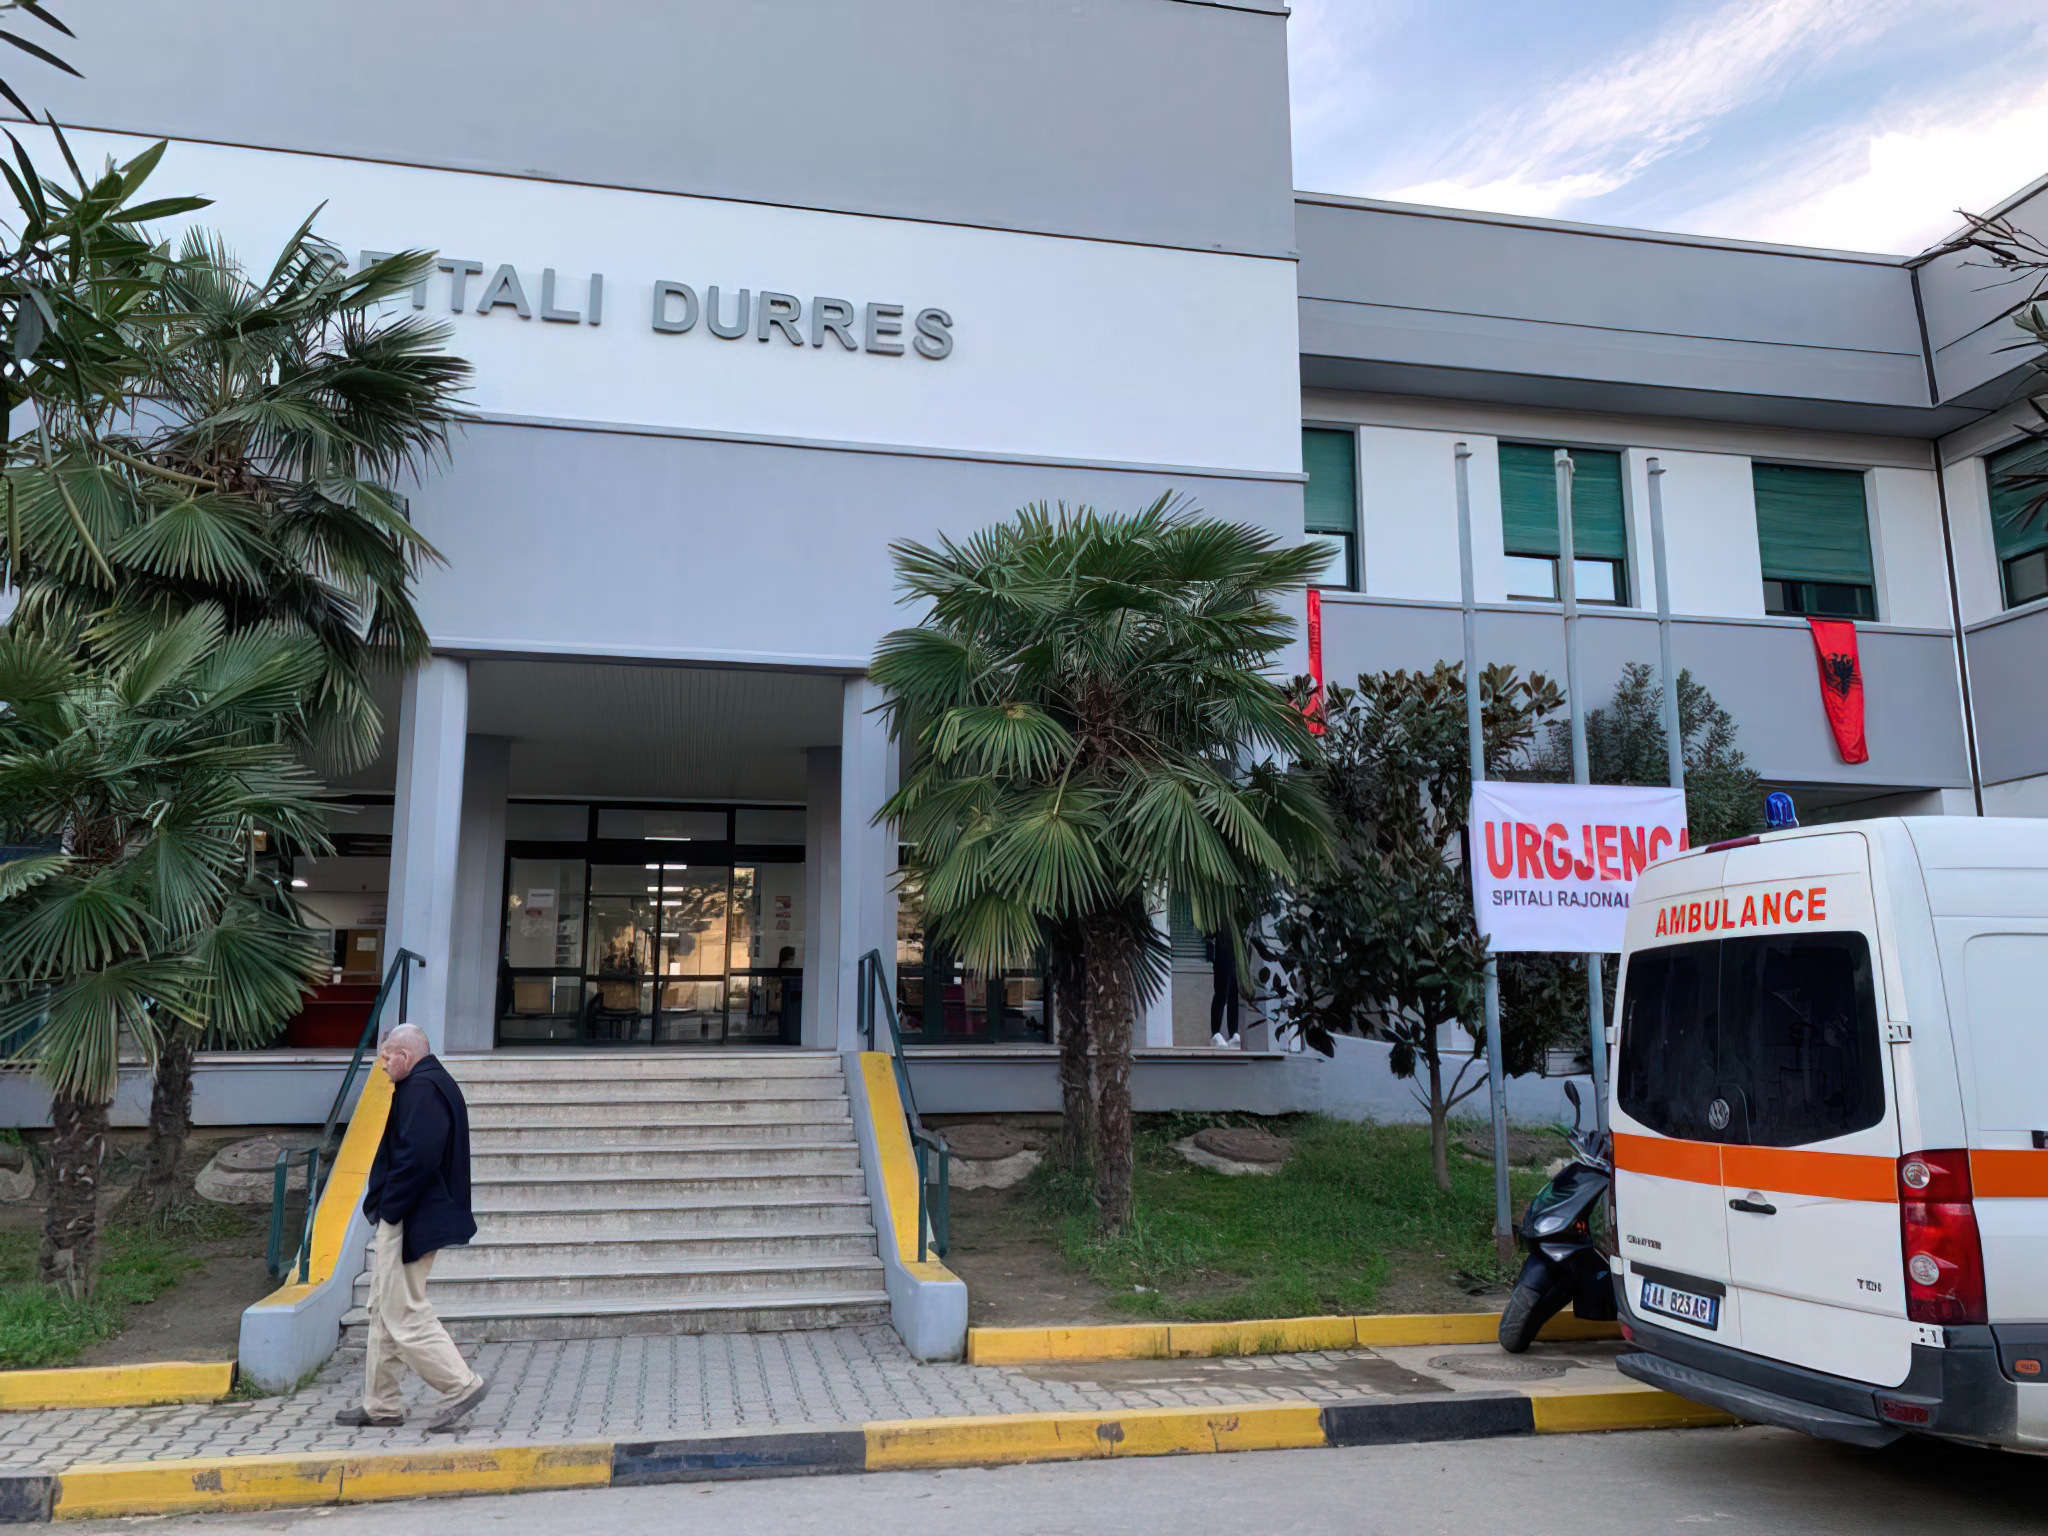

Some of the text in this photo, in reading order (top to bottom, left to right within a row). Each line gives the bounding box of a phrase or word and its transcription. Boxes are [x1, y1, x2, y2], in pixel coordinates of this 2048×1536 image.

[651, 279, 954, 360] DURRES
[1484, 821, 1689, 881] URGJENC
[1492, 890, 1553, 907] SPITALI
[1655, 887, 1826, 937] AMBULANCE
